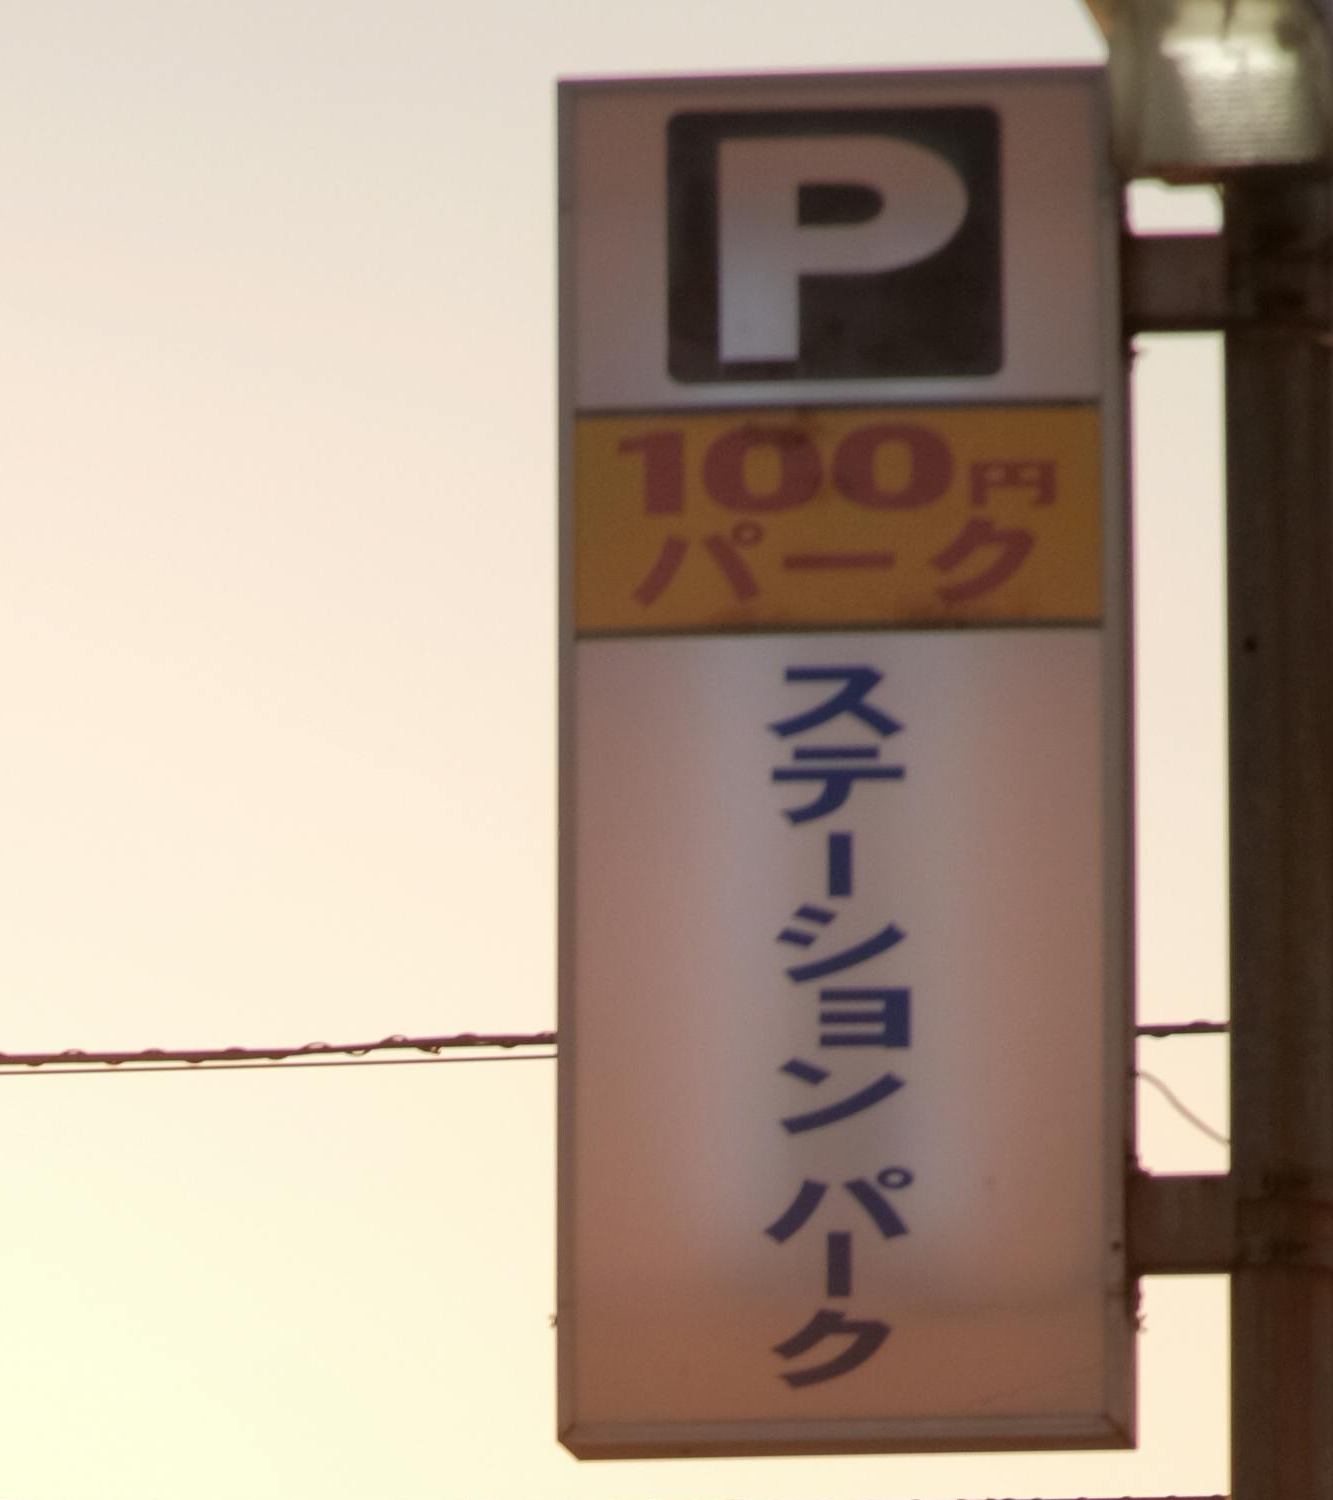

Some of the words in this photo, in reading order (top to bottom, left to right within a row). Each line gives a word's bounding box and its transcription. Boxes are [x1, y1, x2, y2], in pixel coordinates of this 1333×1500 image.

[717, 133, 971, 365] P
[616, 421, 1058, 518] 100円
[634, 517, 1039, 608] パーク
[767, 663, 913, 1137] ステーション
[764, 1165, 915, 1390] パーク
